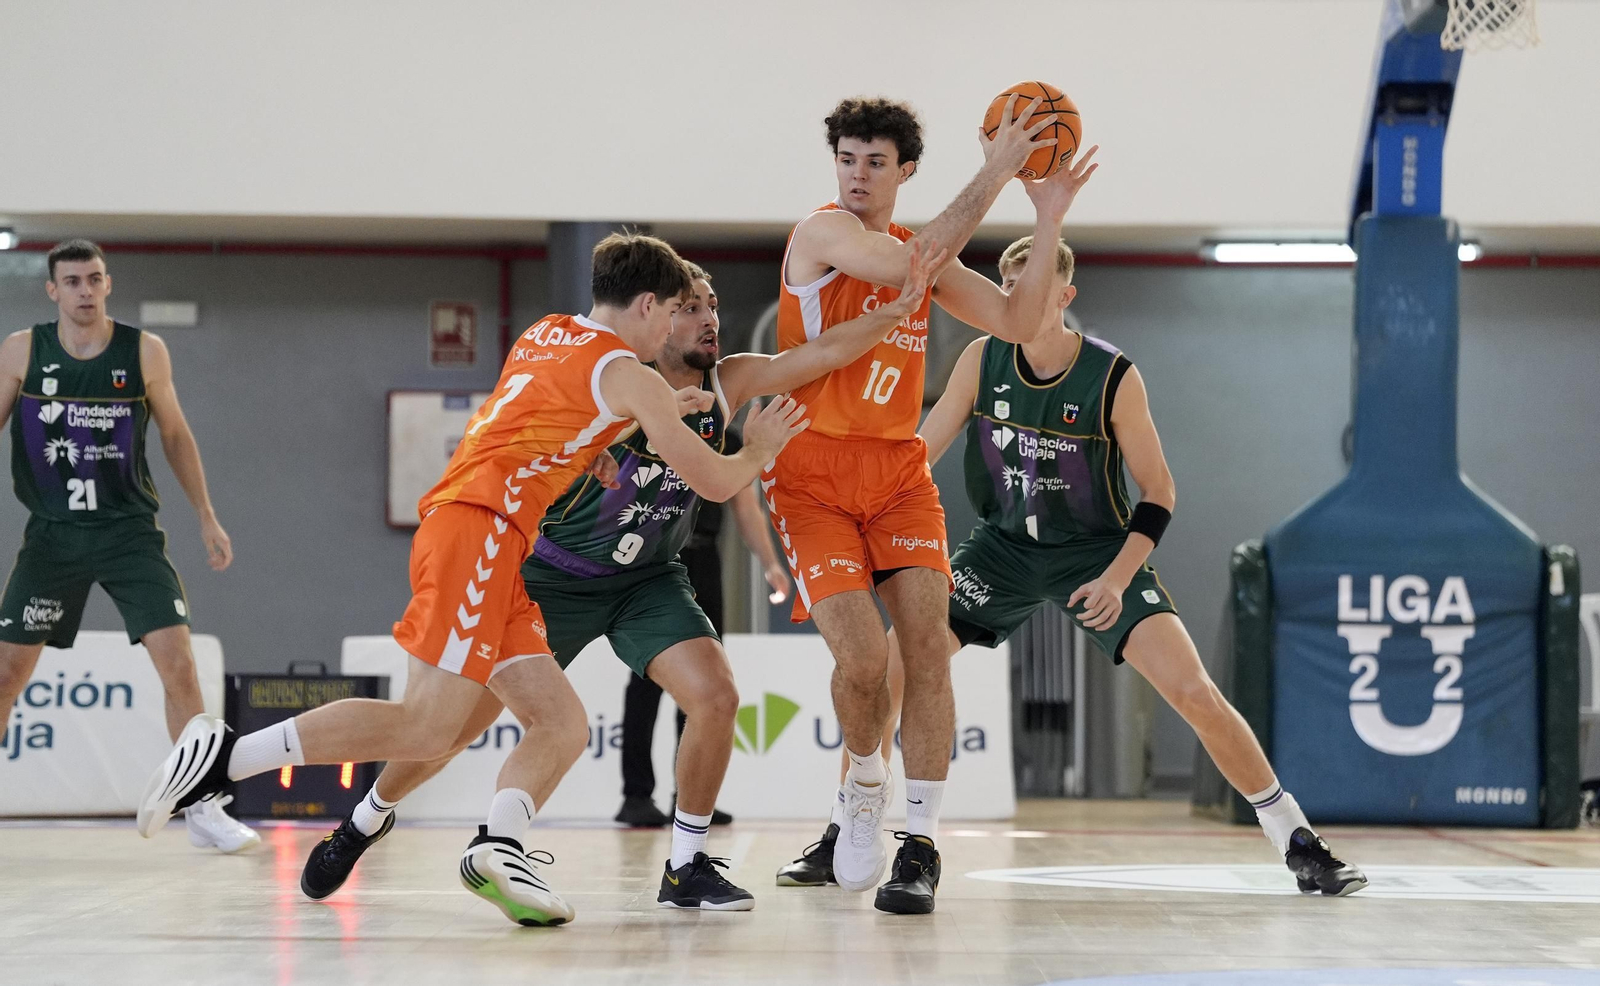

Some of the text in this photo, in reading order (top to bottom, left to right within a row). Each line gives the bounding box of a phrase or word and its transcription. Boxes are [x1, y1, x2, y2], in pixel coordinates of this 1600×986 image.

[911, 317, 928, 331] del
[524, 320, 598, 347] BLANO
[861, 359, 902, 405] 10
[67, 404, 132, 417] Fundación
[467, 372, 535, 435] 7
[1063, 402, 1079, 412] LIGA
[67, 415, 115, 432] Unicaja
[700, 416, 714, 424] IGA
[1018, 432, 1078, 453] Funación
[66, 477, 98, 511] 21
[1046, 483, 1071, 491] Torre
[612, 532, 645, 565] 9
[892, 534, 939, 551] Frigicoll
[1337, 574, 1476, 624] LIGA
[1456, 786, 1528, 804] MONDO
